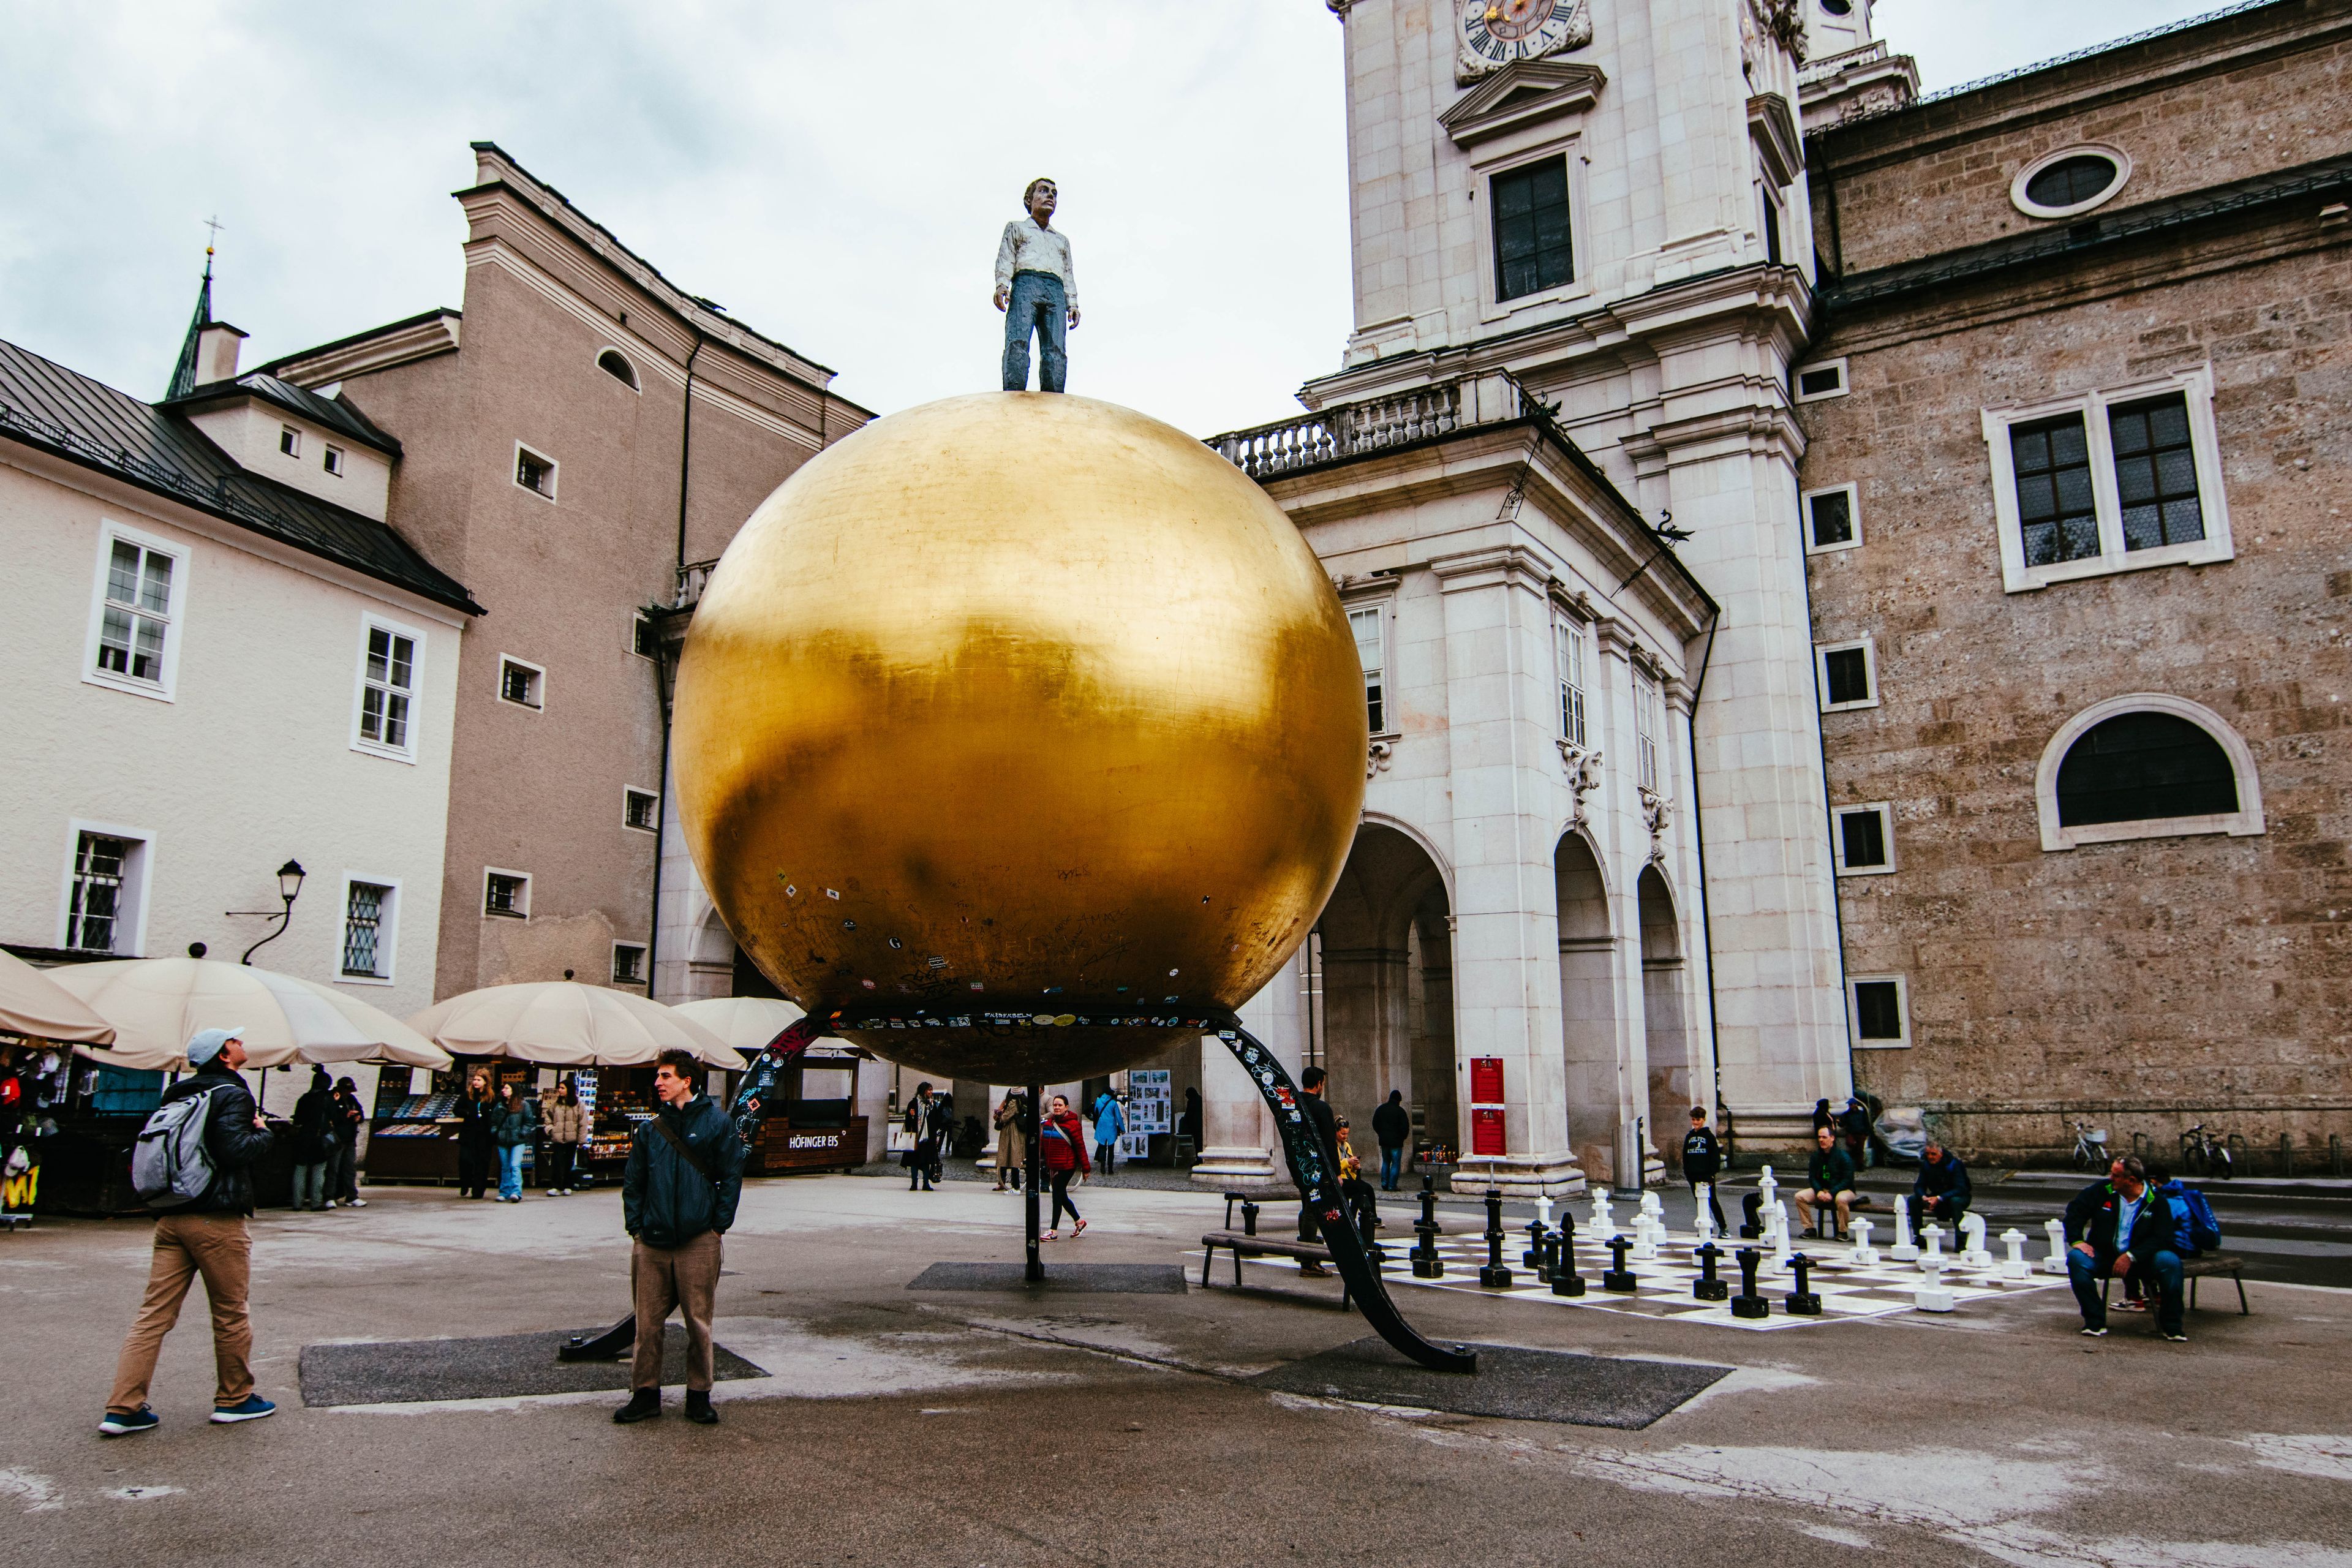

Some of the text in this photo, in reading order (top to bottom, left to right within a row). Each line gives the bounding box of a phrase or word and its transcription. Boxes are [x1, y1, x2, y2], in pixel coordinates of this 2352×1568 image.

[889, 938, 901, 949] G
[790, 1134, 839, 1148] HÖFINGER EIS
